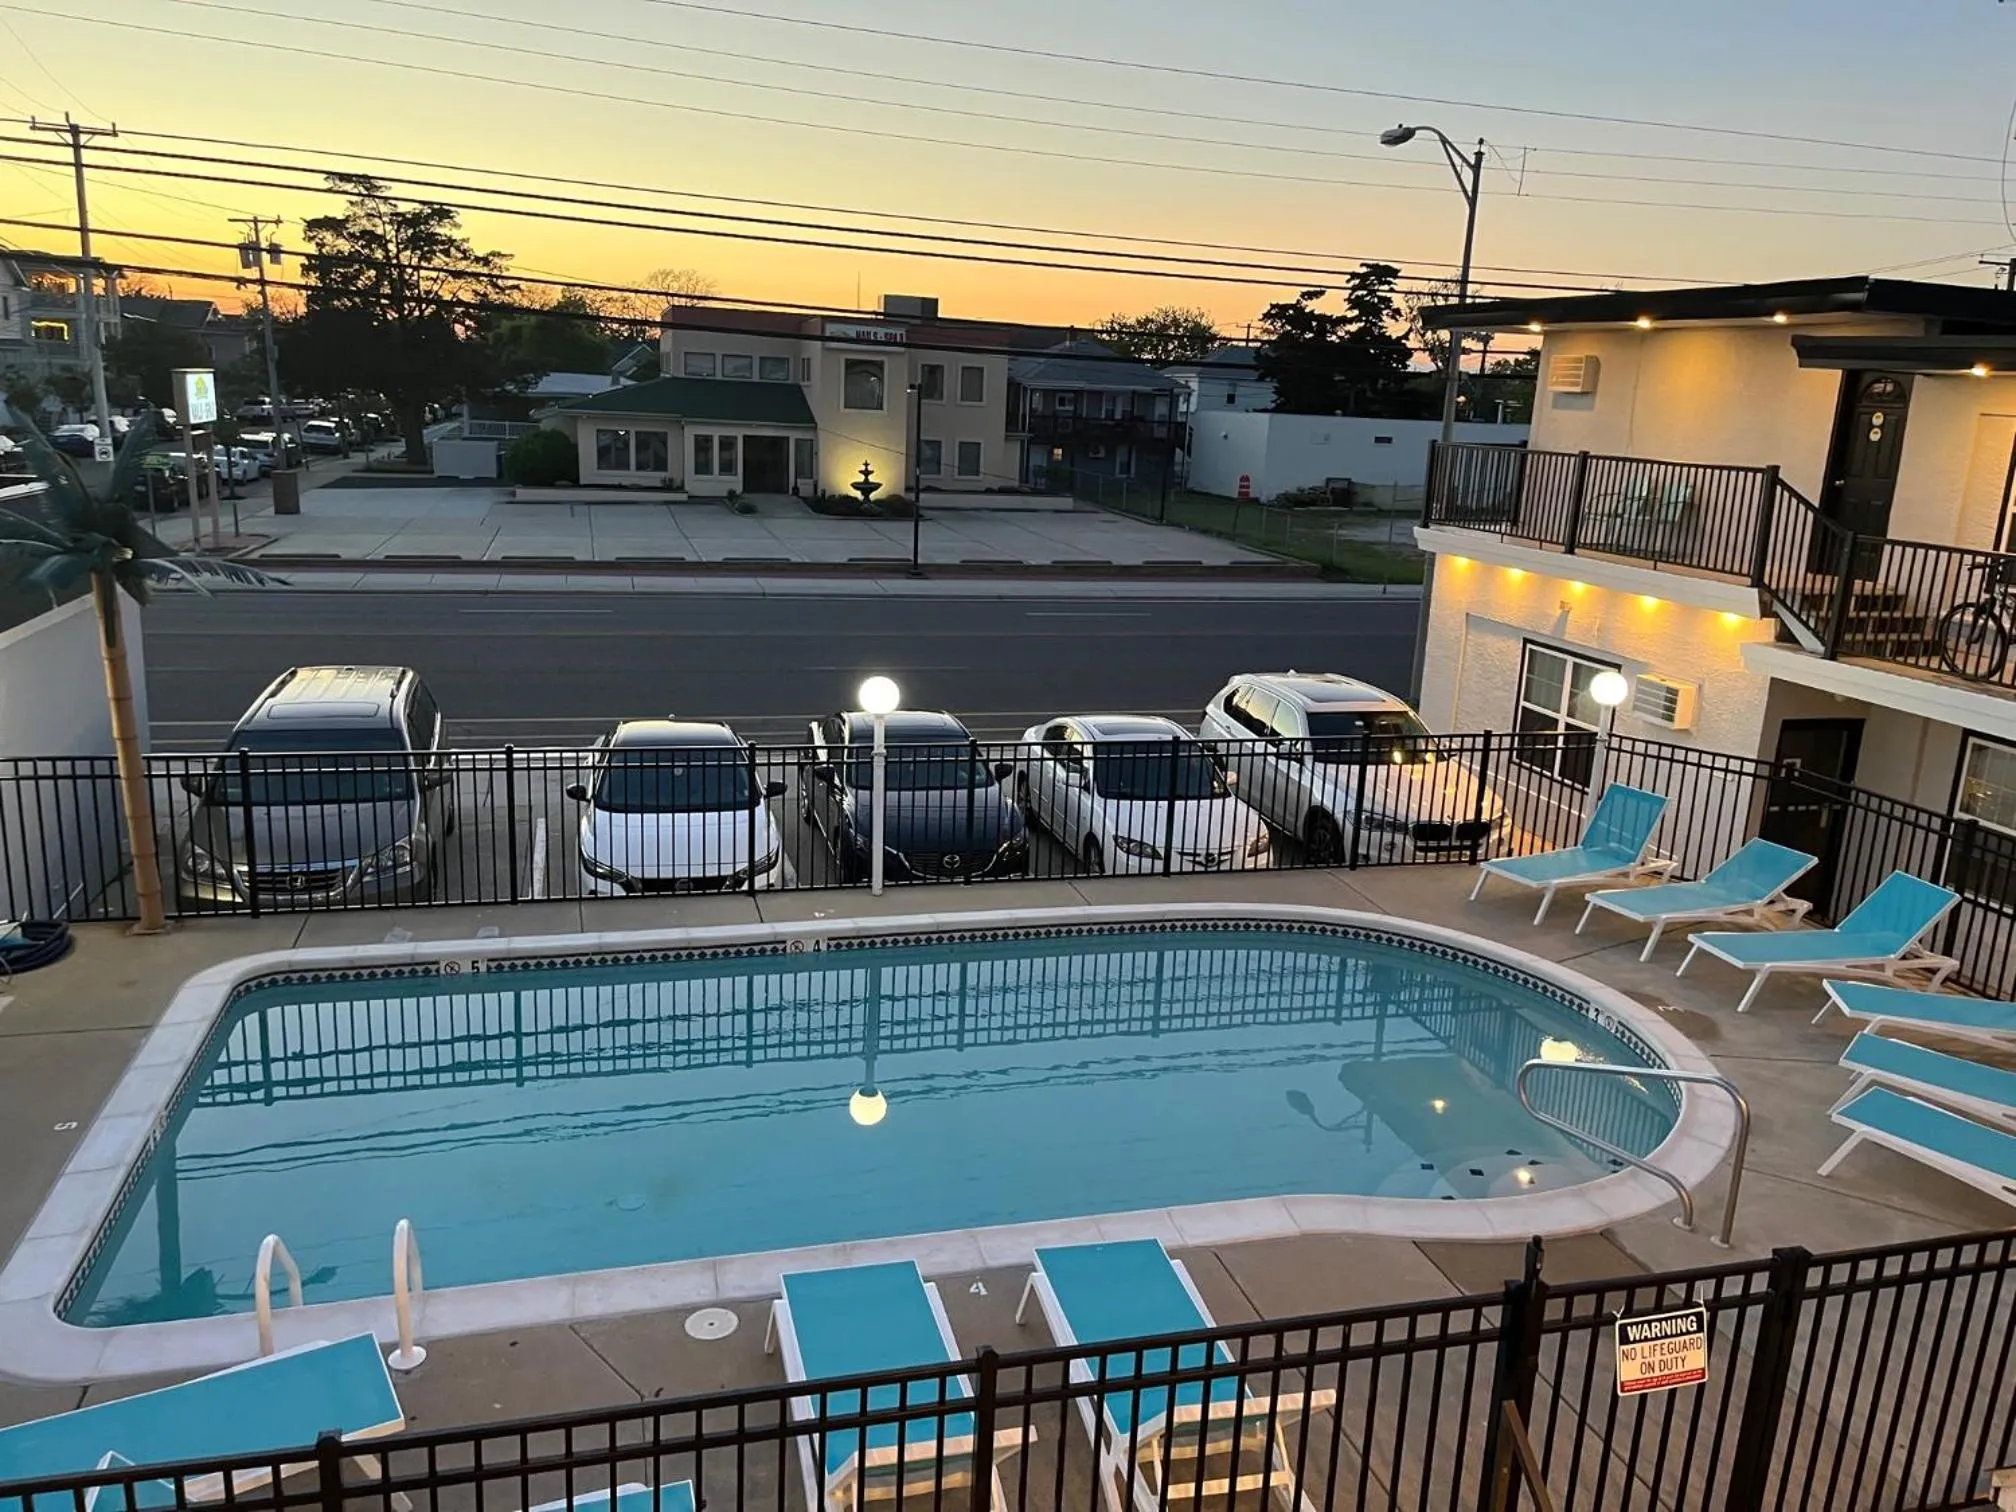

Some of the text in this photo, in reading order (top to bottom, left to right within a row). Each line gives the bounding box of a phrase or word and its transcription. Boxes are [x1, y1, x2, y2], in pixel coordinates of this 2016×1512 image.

[813, 939, 822, 952] 4
[471, 960, 480, 973] 5
[968, 1281, 989, 1296] 4
[1627, 1315, 1697, 1342] WARNING
[1621, 1336, 1703, 1362] NO LIFEGUARD
[1640, 1355, 1688, 1376] ON DUTY
